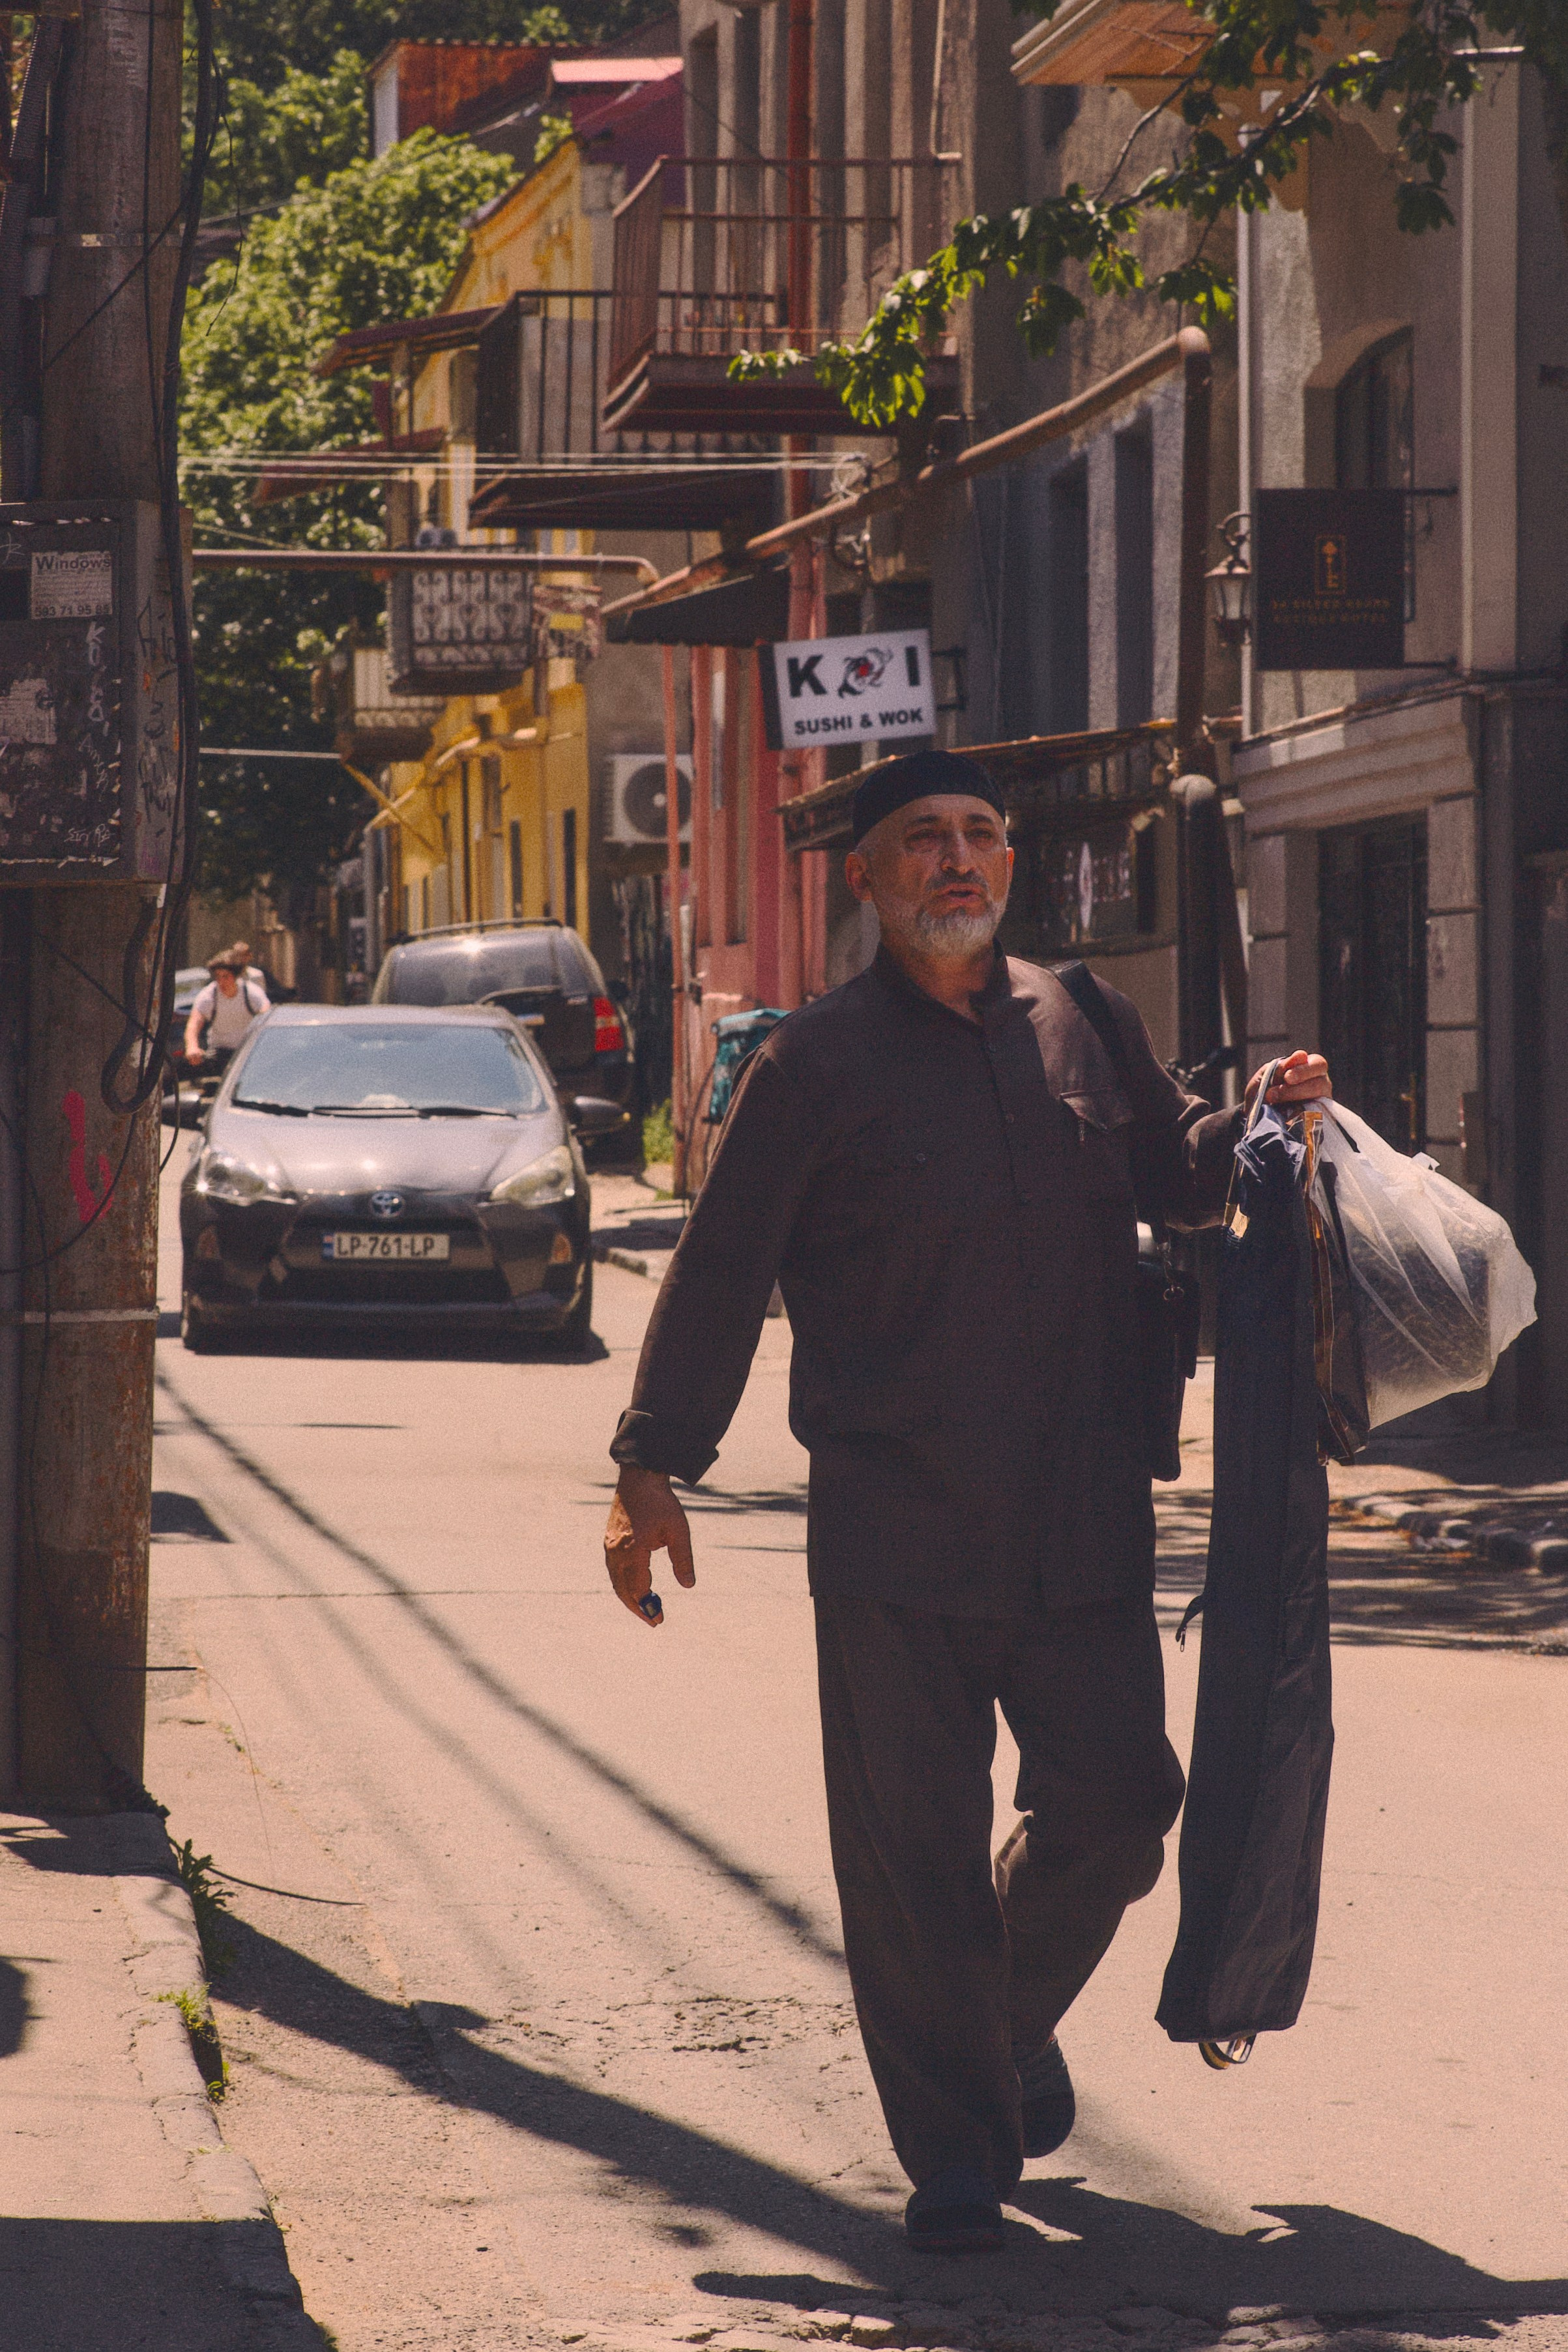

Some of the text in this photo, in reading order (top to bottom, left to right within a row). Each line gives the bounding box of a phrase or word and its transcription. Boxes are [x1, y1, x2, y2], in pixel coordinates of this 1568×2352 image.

[36, 556, 111, 570] Windows
[794, 708, 923, 735] SUSHI & WOK
